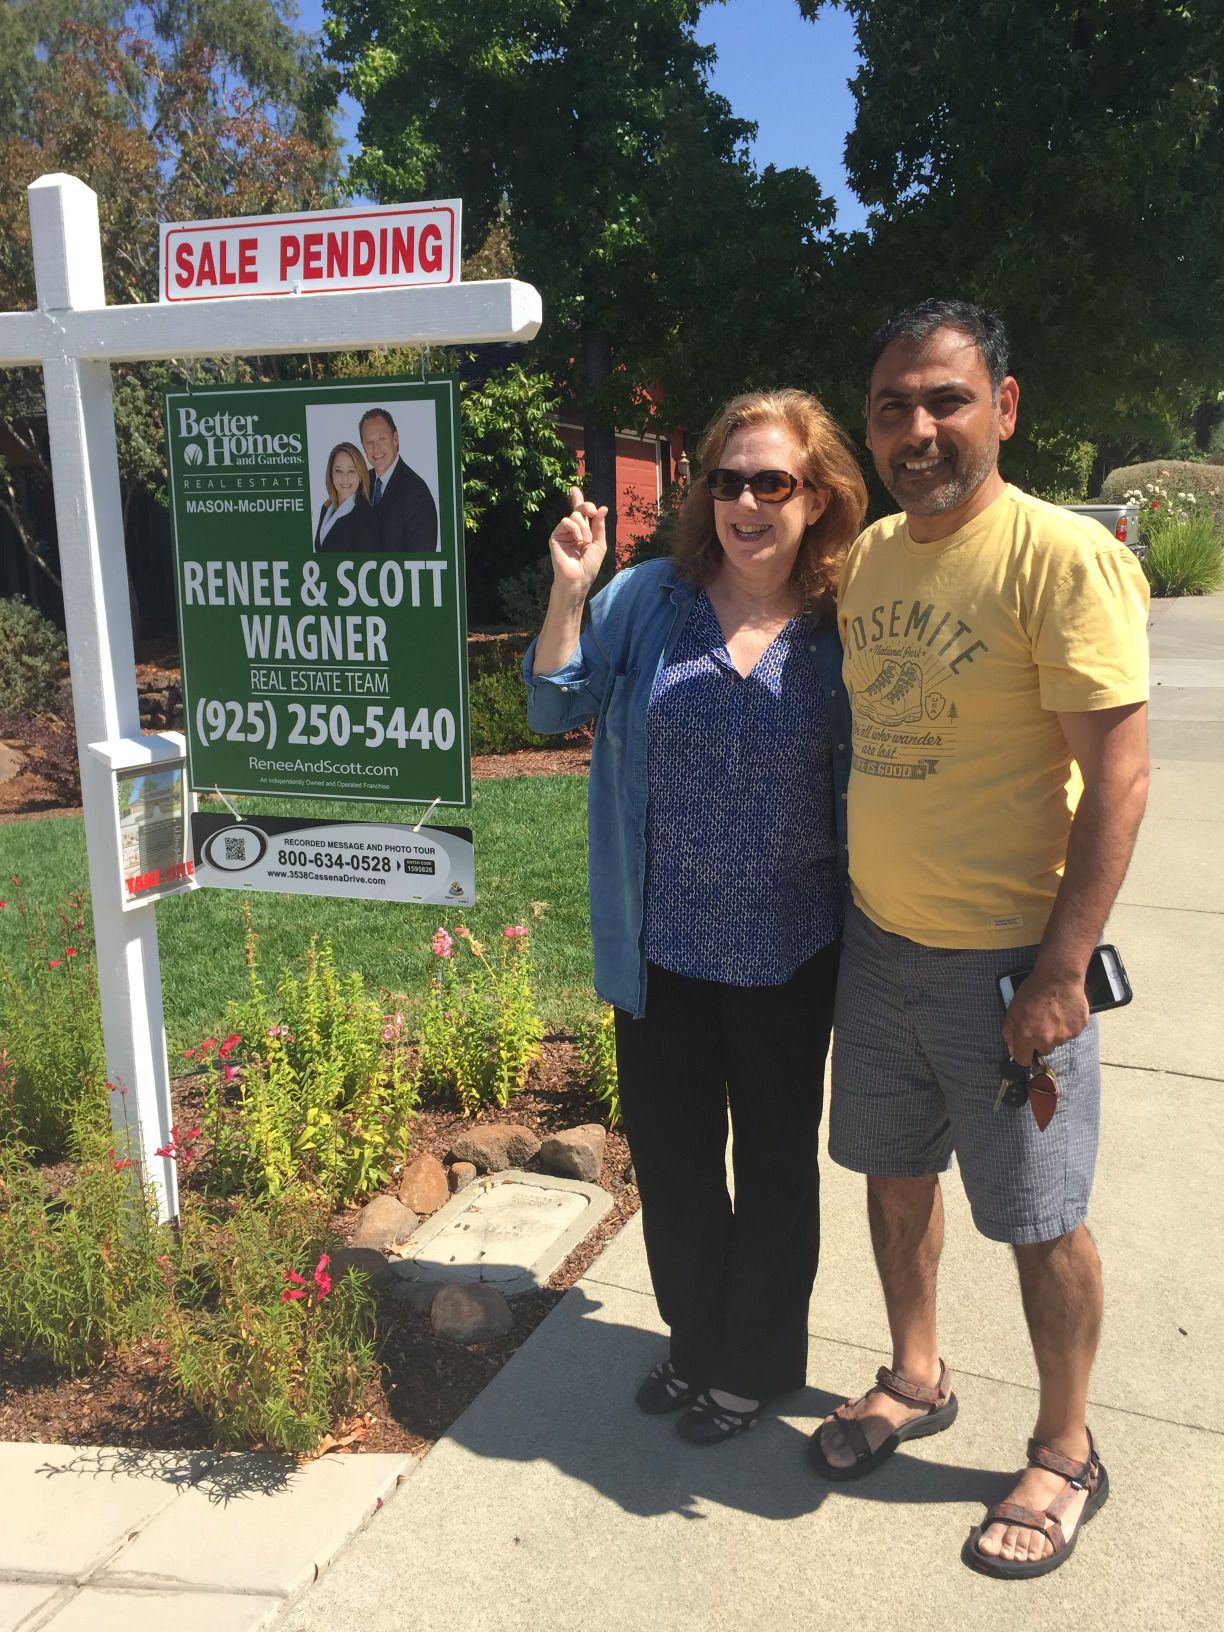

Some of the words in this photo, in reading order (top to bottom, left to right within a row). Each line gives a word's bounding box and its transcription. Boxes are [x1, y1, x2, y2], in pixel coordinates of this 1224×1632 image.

[175, 238, 258, 288] SALE
[280, 223, 443, 281] PENDING
[177, 408, 259, 438] Better
[205, 433, 302, 466] Homes
[236, 453, 256, 465] and
[257, 453, 302, 465] Gardens
[183, 479, 227, 489] REAL
[237, 477, 303, 488] ESTATE
[186, 499, 304, 513] MASON-McDUFFIE
[183, 560, 291, 606] RENEE
[300, 560, 328, 607] &
[336, 560, 447, 608] SCOTT
[240, 614, 389, 661] WAGNER
[250, 669, 287, 690] REAL
[291, 671, 341, 692] ESTATE
[345, 673, 389, 693] TEAM
[196, 698, 277, 750] (925)
[287, 703, 456, 751] 250-5440
[871, 727, 892, 742] who
[892, 732, 943, 746] wander
[861, 744, 875, 757] are
[249, 757, 399, 777] ReneeAndScott.com
[867, 761, 878, 774] IS
[877, 764, 913, 777] GOOD
[268, 777, 305, 787] Independently
[305, 779, 325, 787] Owned
[363, 782, 391, 790] Franchise
[284, 838, 326, 848] RECORDED
[328, 841, 365, 851] MESSAGE
[366, 843, 383, 852] AND
[385, 845, 412, 854] PHOTO
[413, 846, 436, 855] TOUR
[278, 850, 392, 872] 800-634-0528
[267, 869, 386, 886] www.3538CassenaDrive.com
